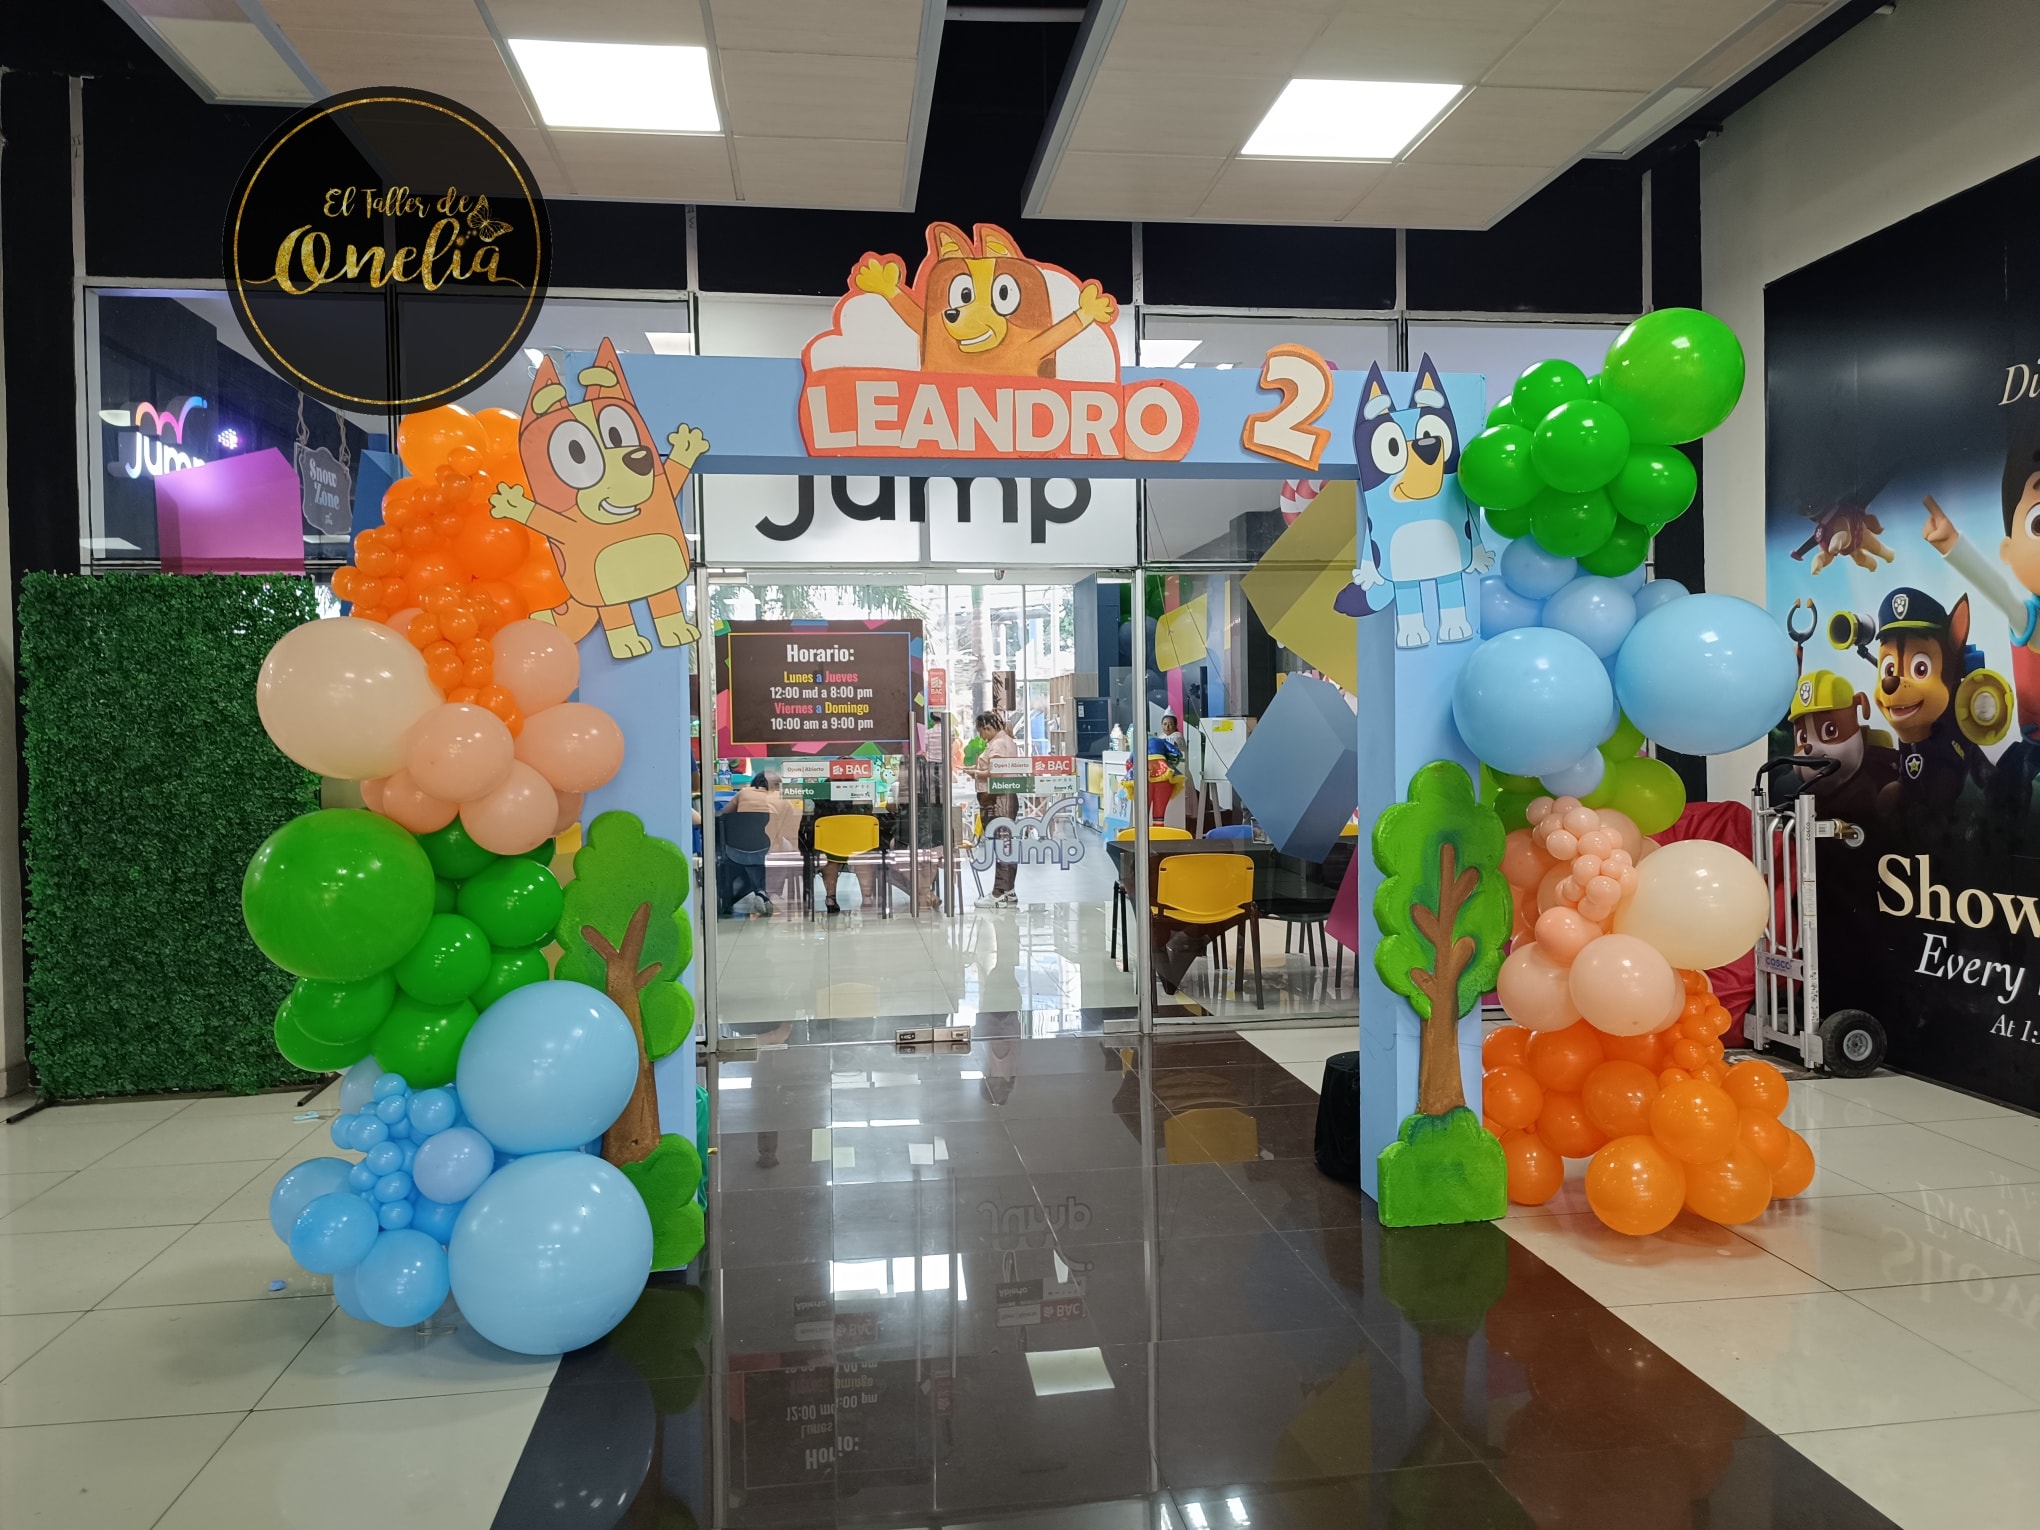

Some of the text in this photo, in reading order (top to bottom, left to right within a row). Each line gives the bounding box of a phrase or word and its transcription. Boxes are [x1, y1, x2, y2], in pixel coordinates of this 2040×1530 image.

[1250, 352, 1329, 464] 2
[807, 380, 1183, 456] LEANDRO
[310, 458, 337, 488] Snow
[314, 481, 340, 510] Zone
[786, 643, 855, 662] Horario:
[783, 671, 858, 683] Lunes a Jueves
[770, 686, 873, 700] 12:00 md a 8:00 pm
[774, 702, 869, 716] Viernes a Domingo
[770, 717, 873, 731] 10:00 am a 9:00 pm
[845, 764, 869, 774] BAC
[1047, 760, 1070, 770] BAC
[784, 788, 815, 796] Abierto
[991, 782, 1021, 790] Abierto
[971, 838, 1086, 872] jump
[1877, 854, 2040, 938] Show
[1765, 956, 1792, 970] COSCO
[1914, 932, 2026, 1005] Every
[1989, 1014, 2040, 1046] At 1:
